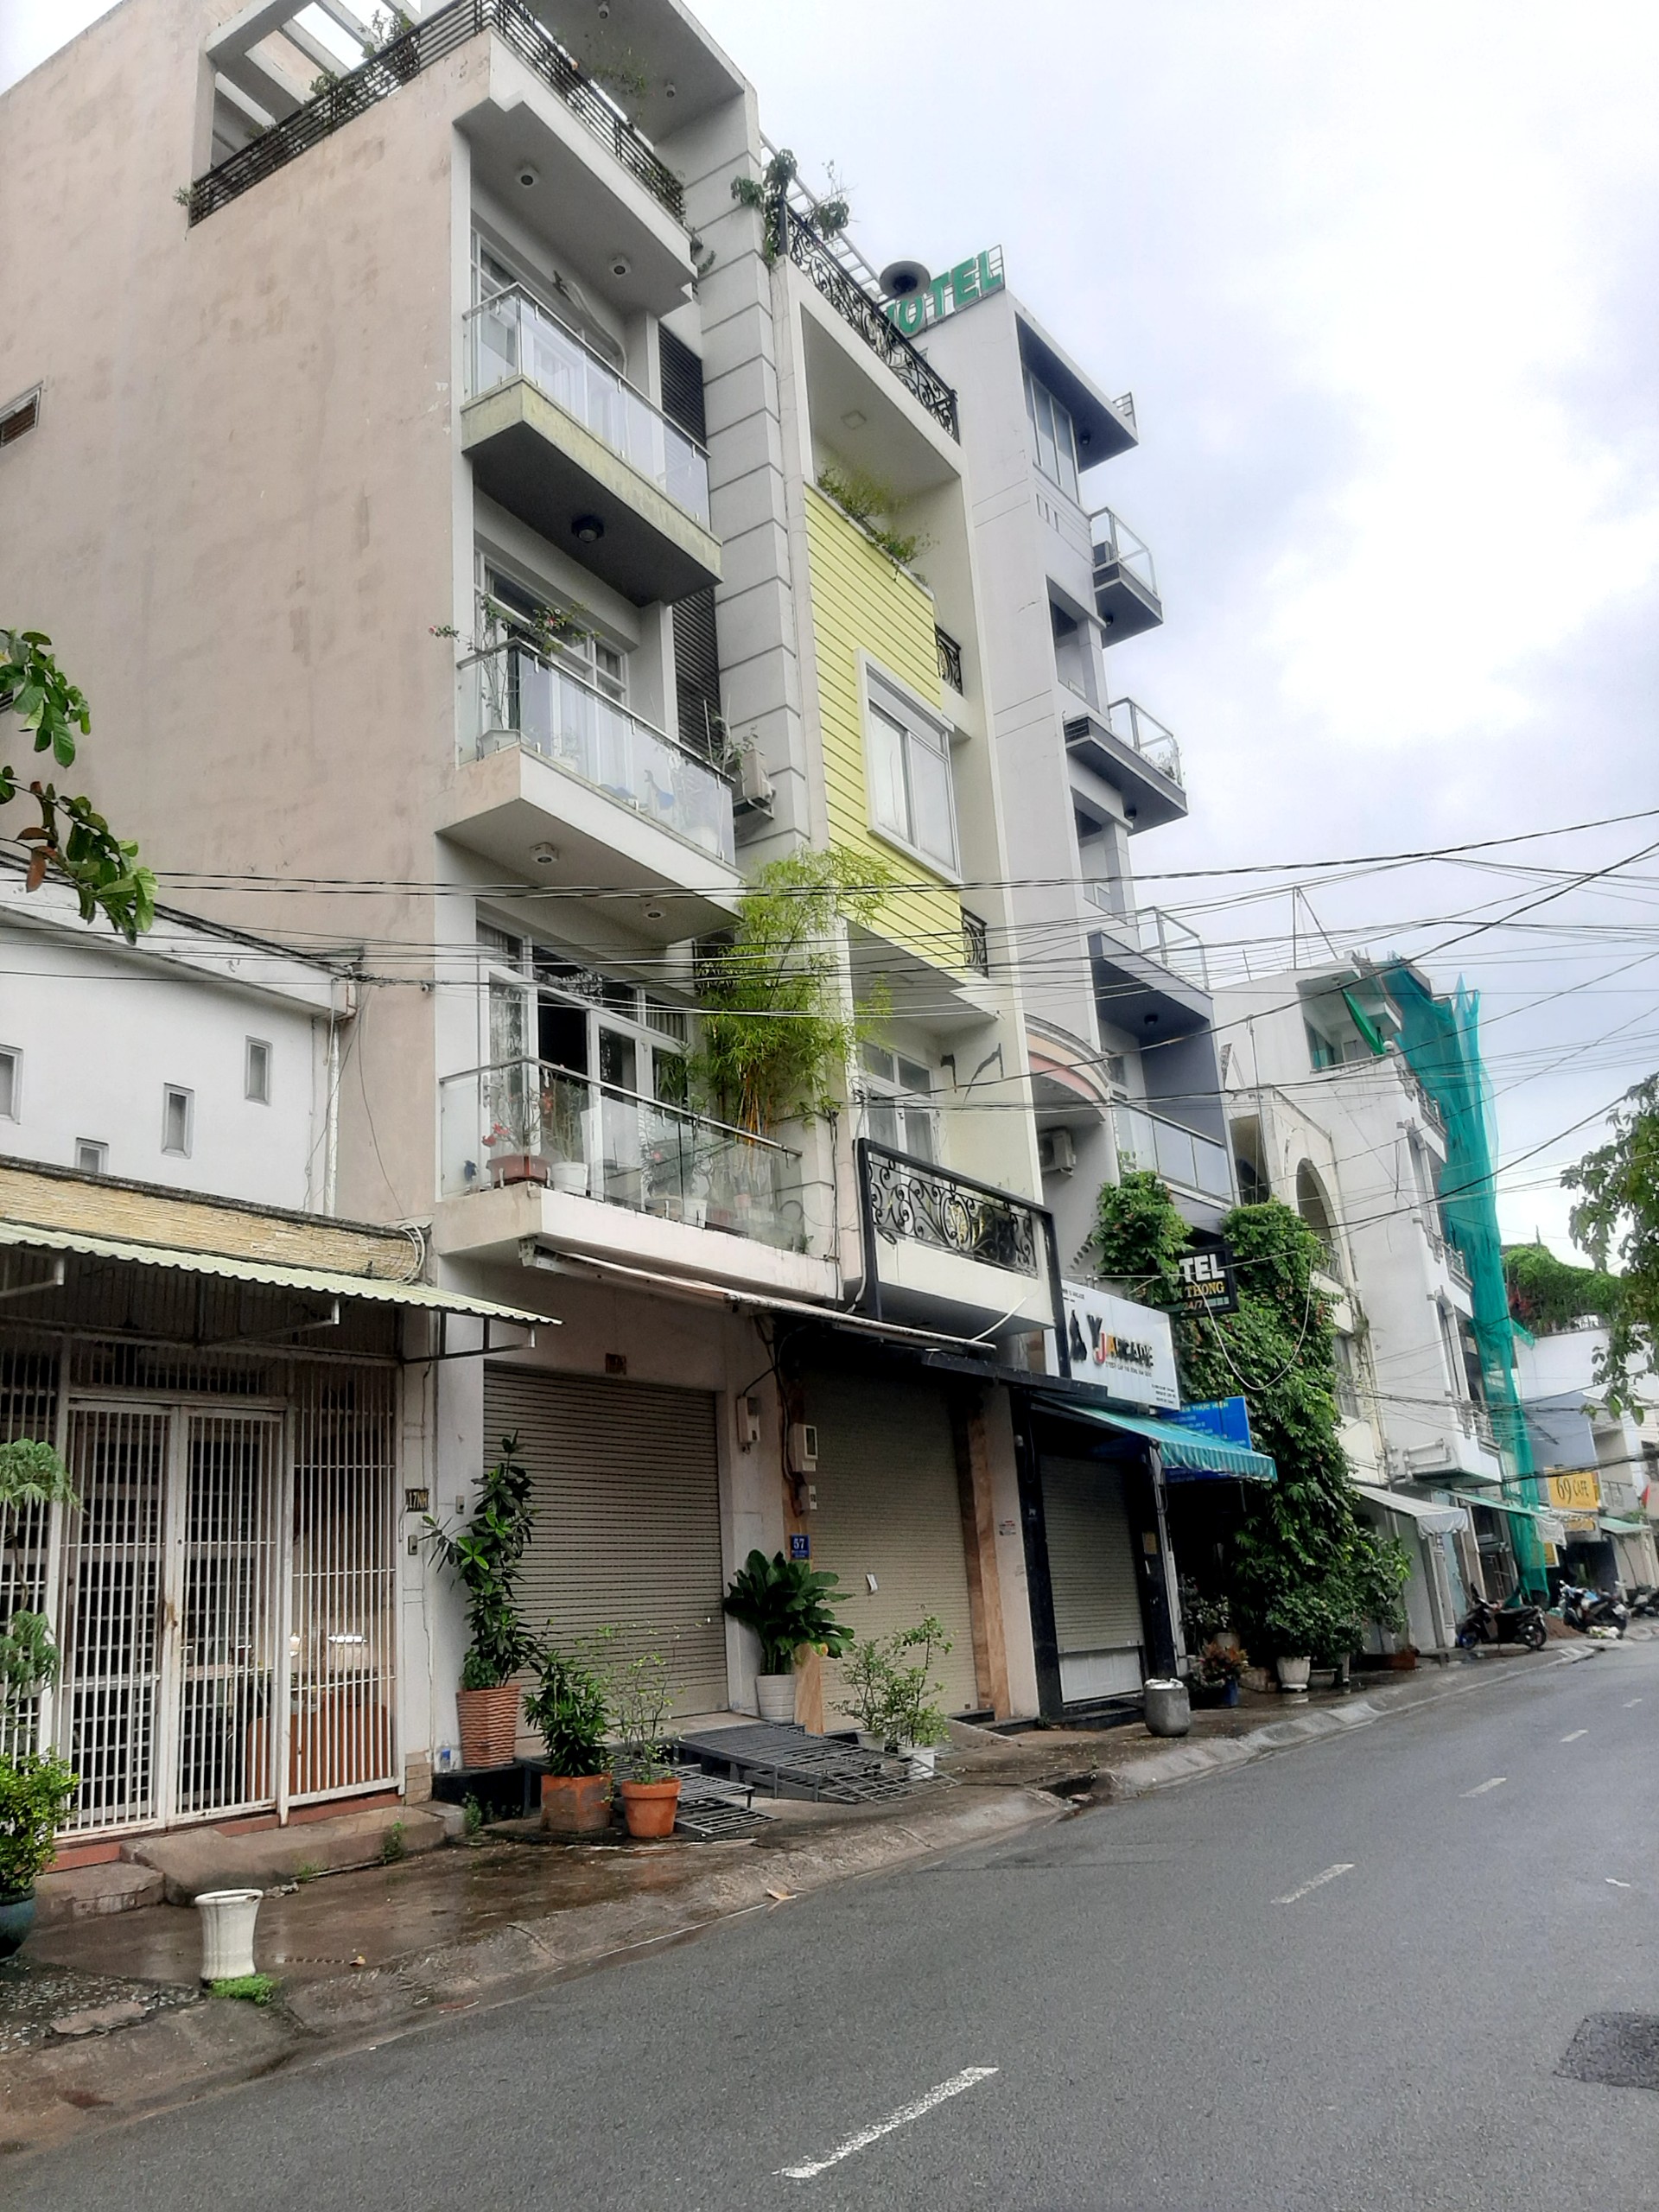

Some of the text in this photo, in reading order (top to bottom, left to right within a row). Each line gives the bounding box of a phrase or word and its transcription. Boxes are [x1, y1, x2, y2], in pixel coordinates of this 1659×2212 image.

[887, 250, 1003, 334] OTEL
[1179, 1254, 1225, 1283] TEL
[1556, 1476, 1572, 1504] 69
[793, 1538, 804, 1549] 57
